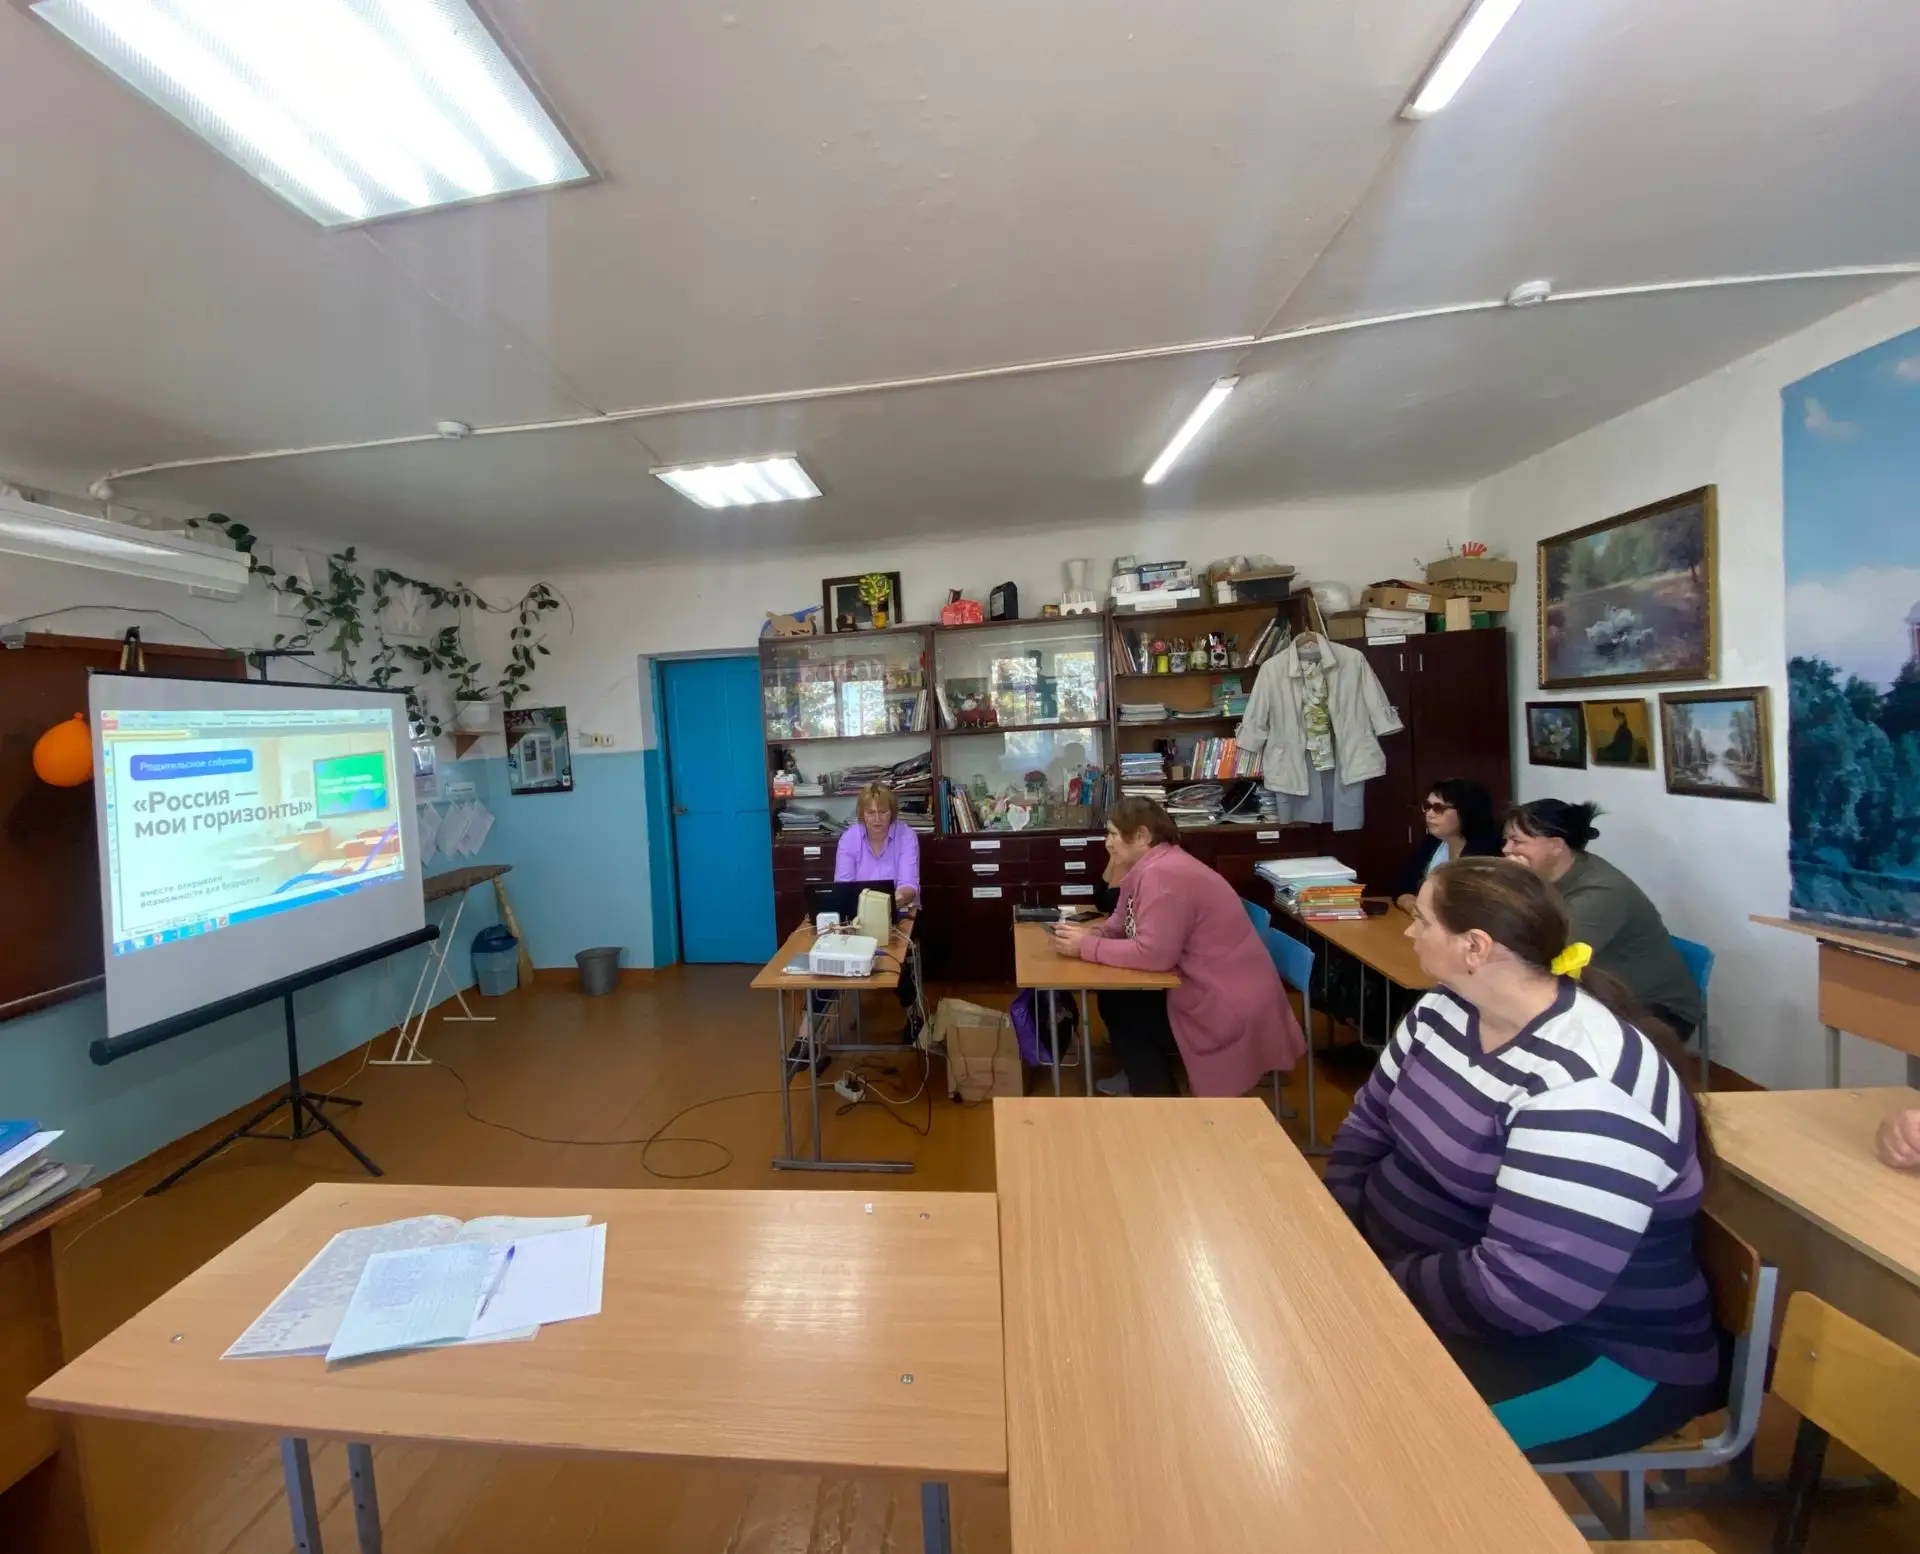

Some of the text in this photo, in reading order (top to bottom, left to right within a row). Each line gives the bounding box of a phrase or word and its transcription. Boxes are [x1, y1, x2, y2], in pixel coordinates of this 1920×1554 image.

[133, 789, 230, 813] «Россия
[135, 800, 313, 838] мои горизонты»
